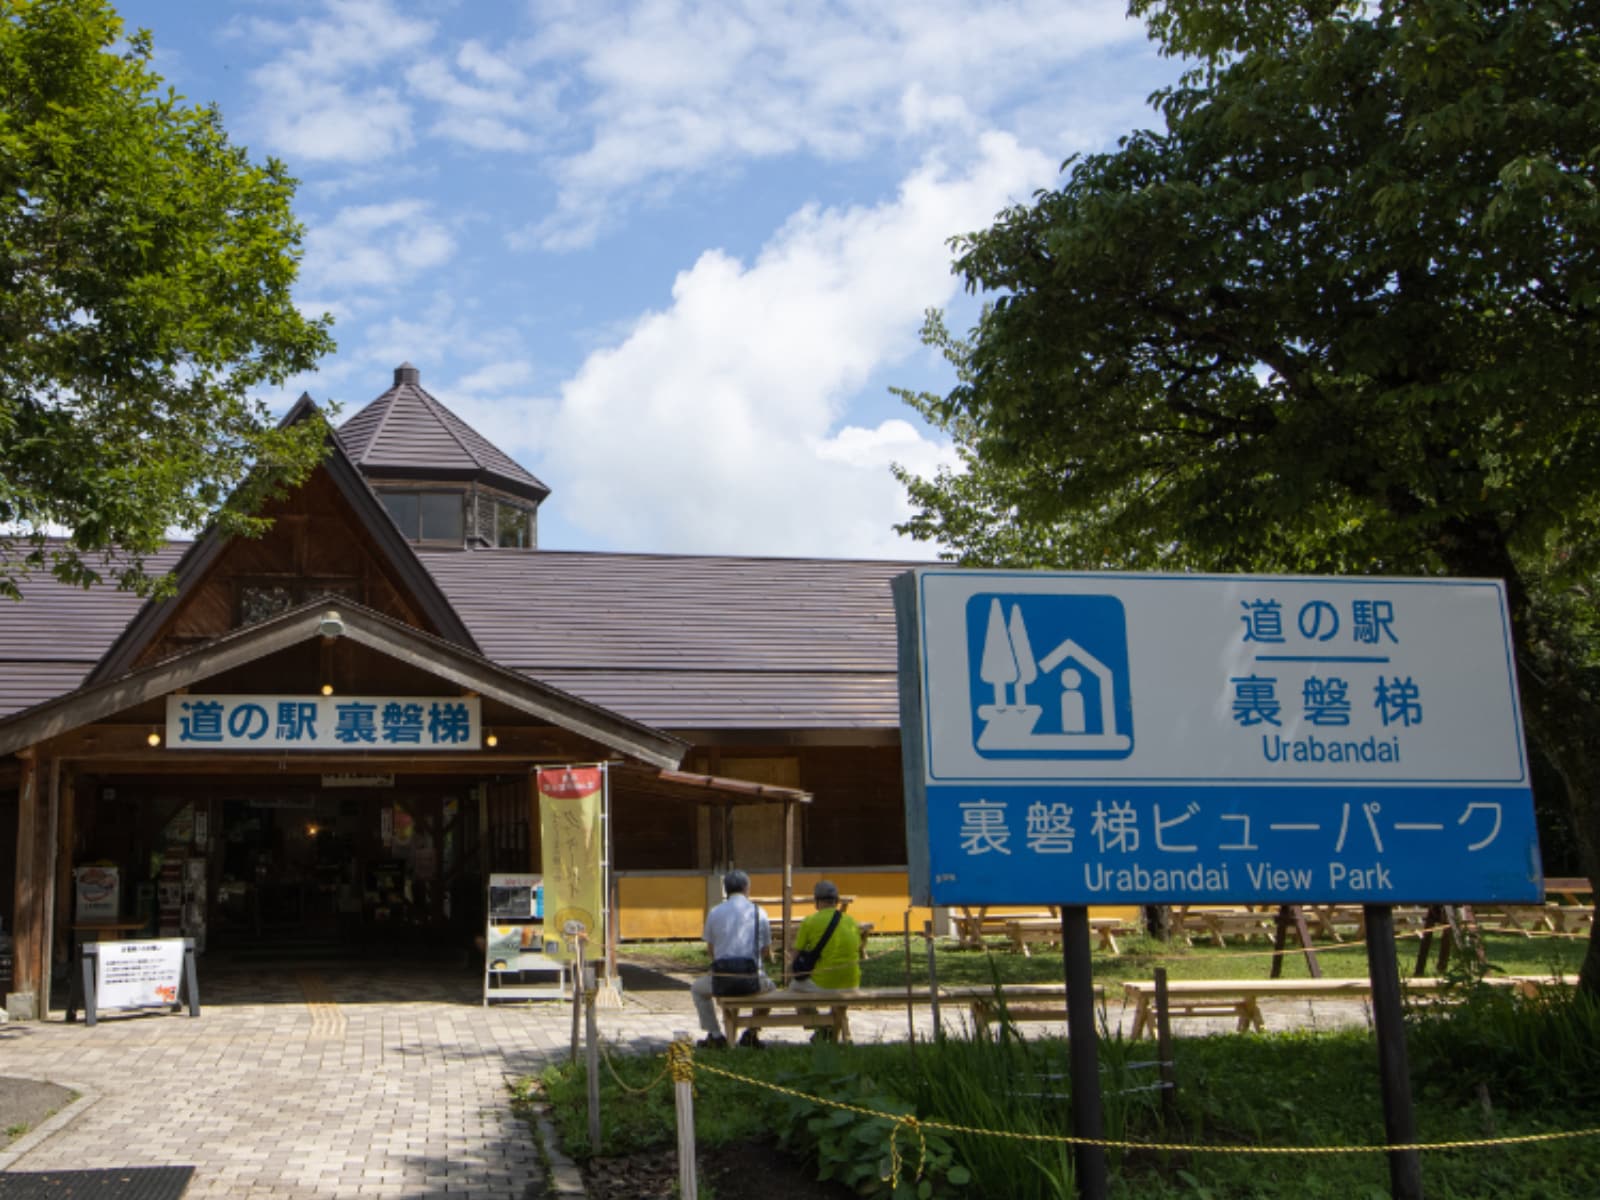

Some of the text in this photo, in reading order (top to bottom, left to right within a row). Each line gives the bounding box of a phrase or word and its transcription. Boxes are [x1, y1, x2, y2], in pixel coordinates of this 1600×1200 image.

[1241, 599, 1398, 644] 道の駅
[179, 701, 470, 744] 道の駅 裏磐梯
[1231, 675, 1423, 728] 裏磐梯
[1262, 735, 1400, 763] Urabandai
[958, 799, 1502, 856] 裏磐梯ビューパーク
[1084, 862, 1393, 891] Urabandai View Park
